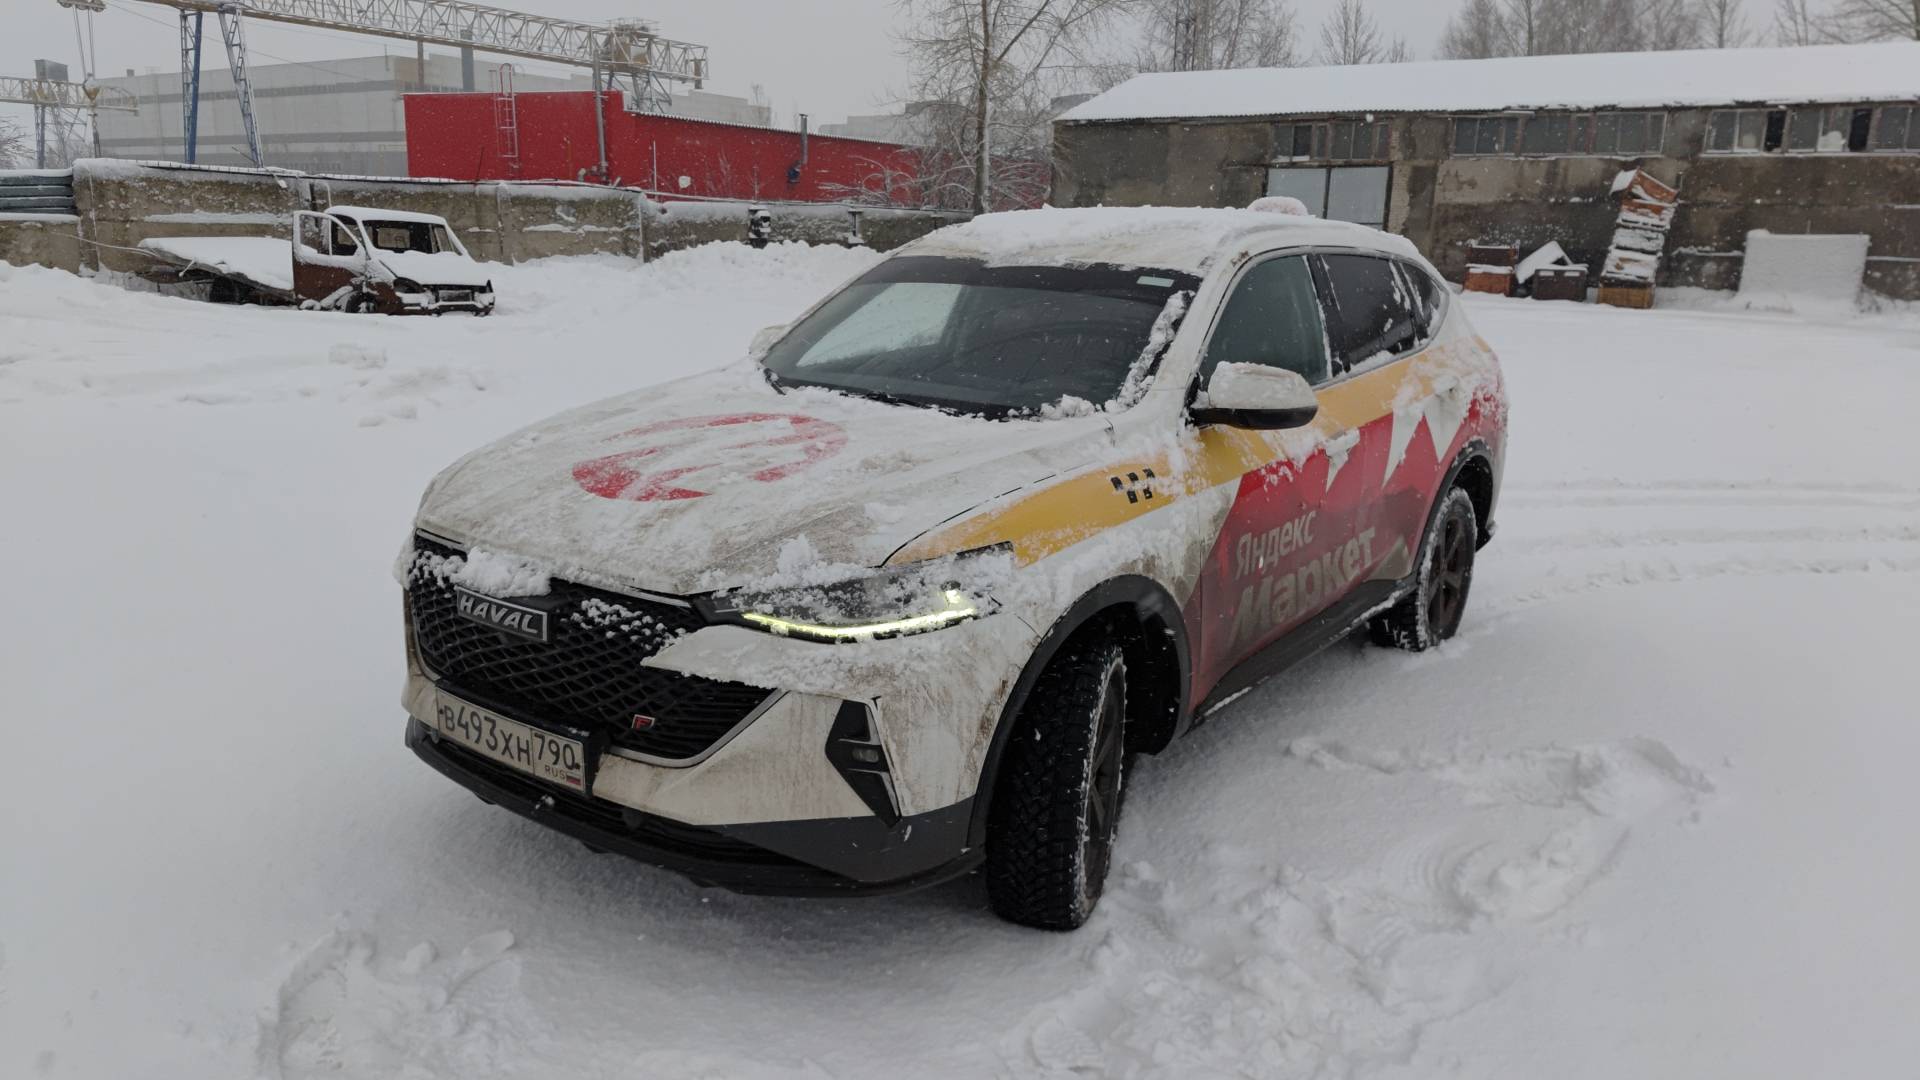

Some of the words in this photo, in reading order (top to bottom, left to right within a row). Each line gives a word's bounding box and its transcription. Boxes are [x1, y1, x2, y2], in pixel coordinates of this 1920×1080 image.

[1234, 510, 1317, 581] Яндекс
[1230, 526, 1376, 647] Маркет
[460, 594, 538, 634] HAVAL
[534, 732, 575, 770] 790
[544, 764, 566, 780] RUS
